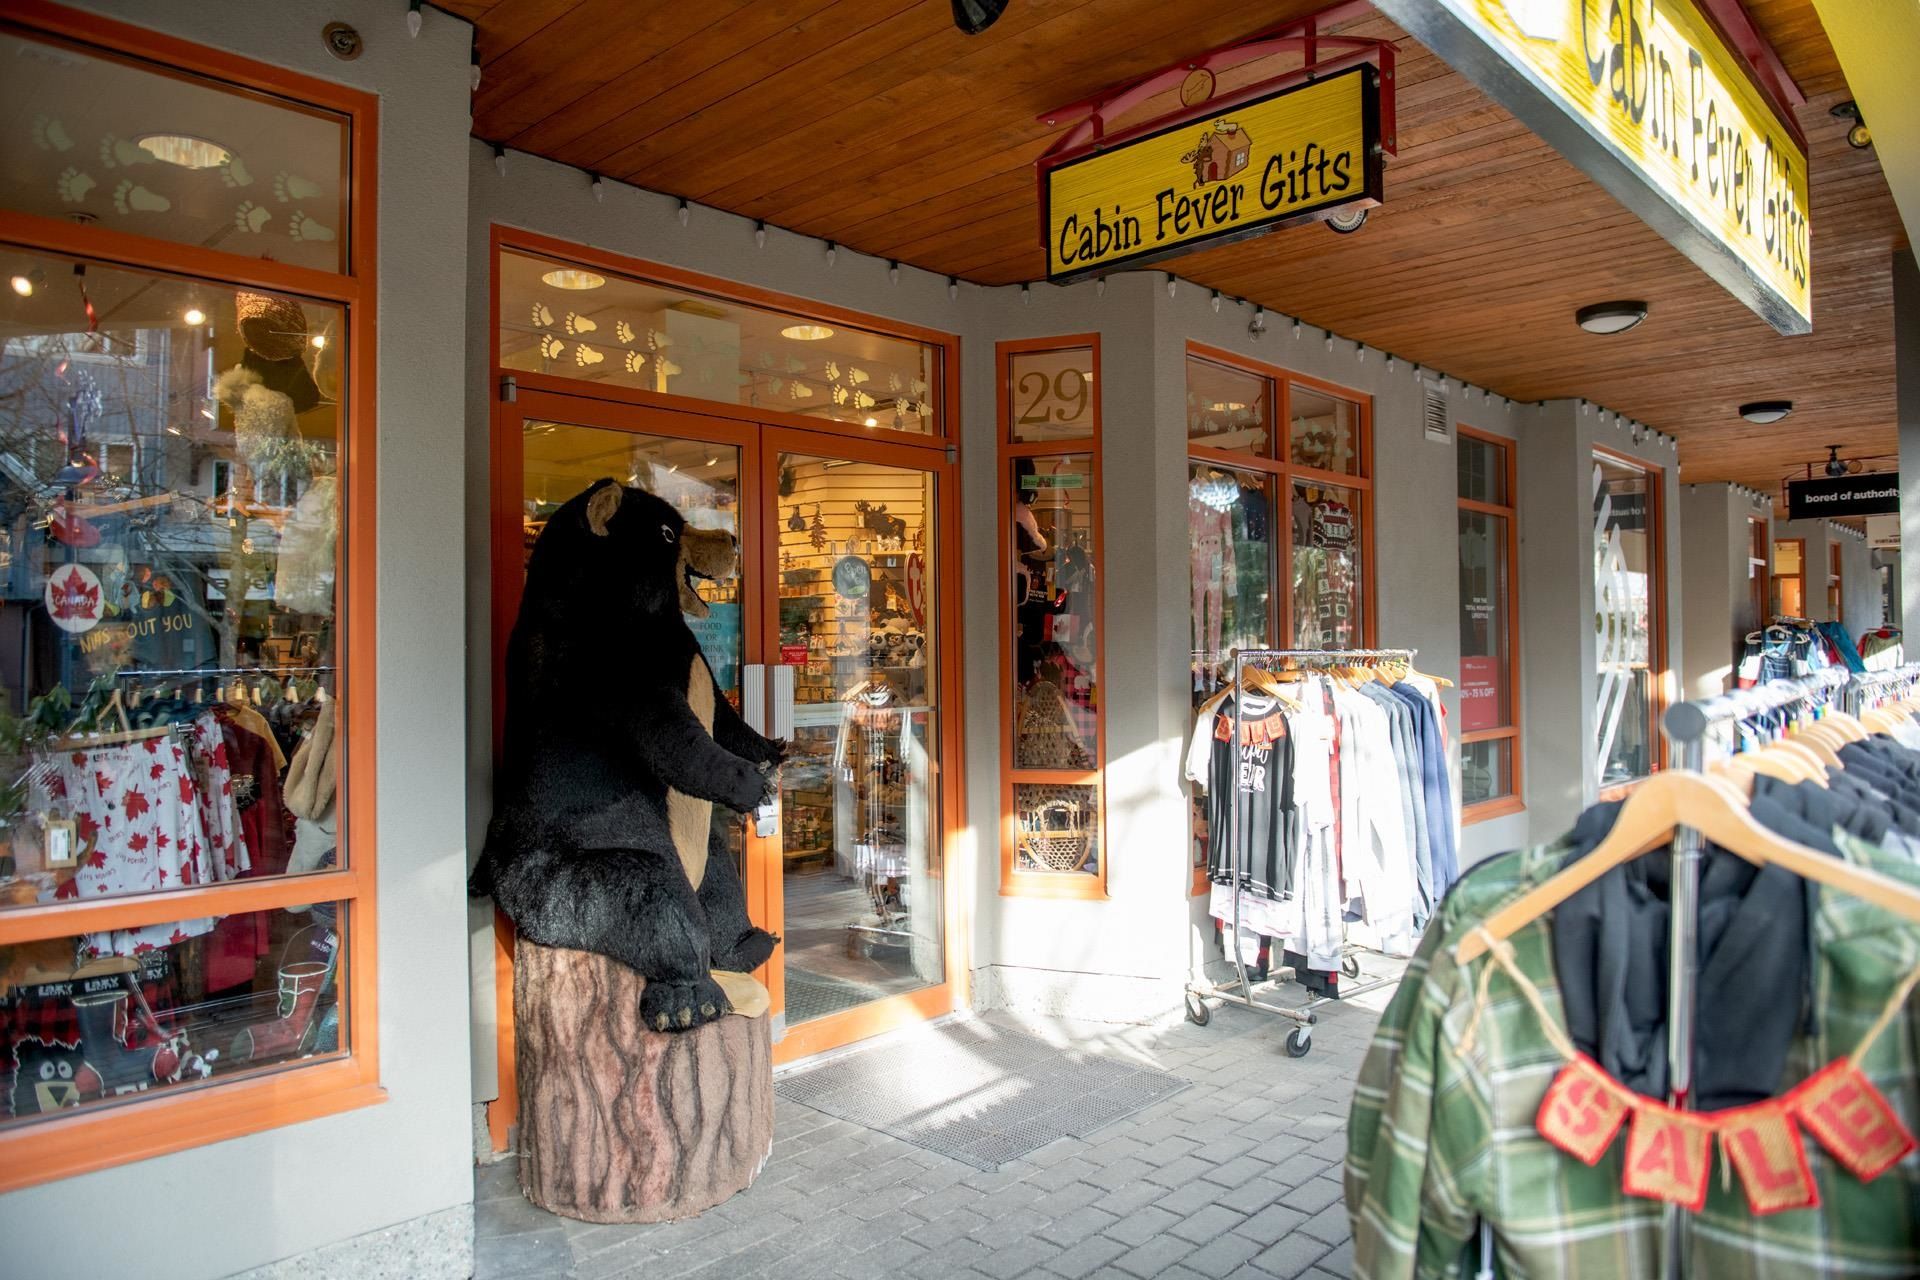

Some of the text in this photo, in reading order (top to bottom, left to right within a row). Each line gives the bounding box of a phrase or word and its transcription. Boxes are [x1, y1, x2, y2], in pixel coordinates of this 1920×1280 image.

[1581, 0, 1806, 290] Cabin Fever Gifts
[1059, 142, 1352, 266] Cabin Fever Gifts
[1017, 368, 1088, 425] 29
[1805, 492, 1838, 504] bored
[1840, 490, 1852, 500] of
[161, 613, 193, 633] YOU
[705, 633, 718, 642] OR
[1556, 1078, 1893, 1192] SALE
